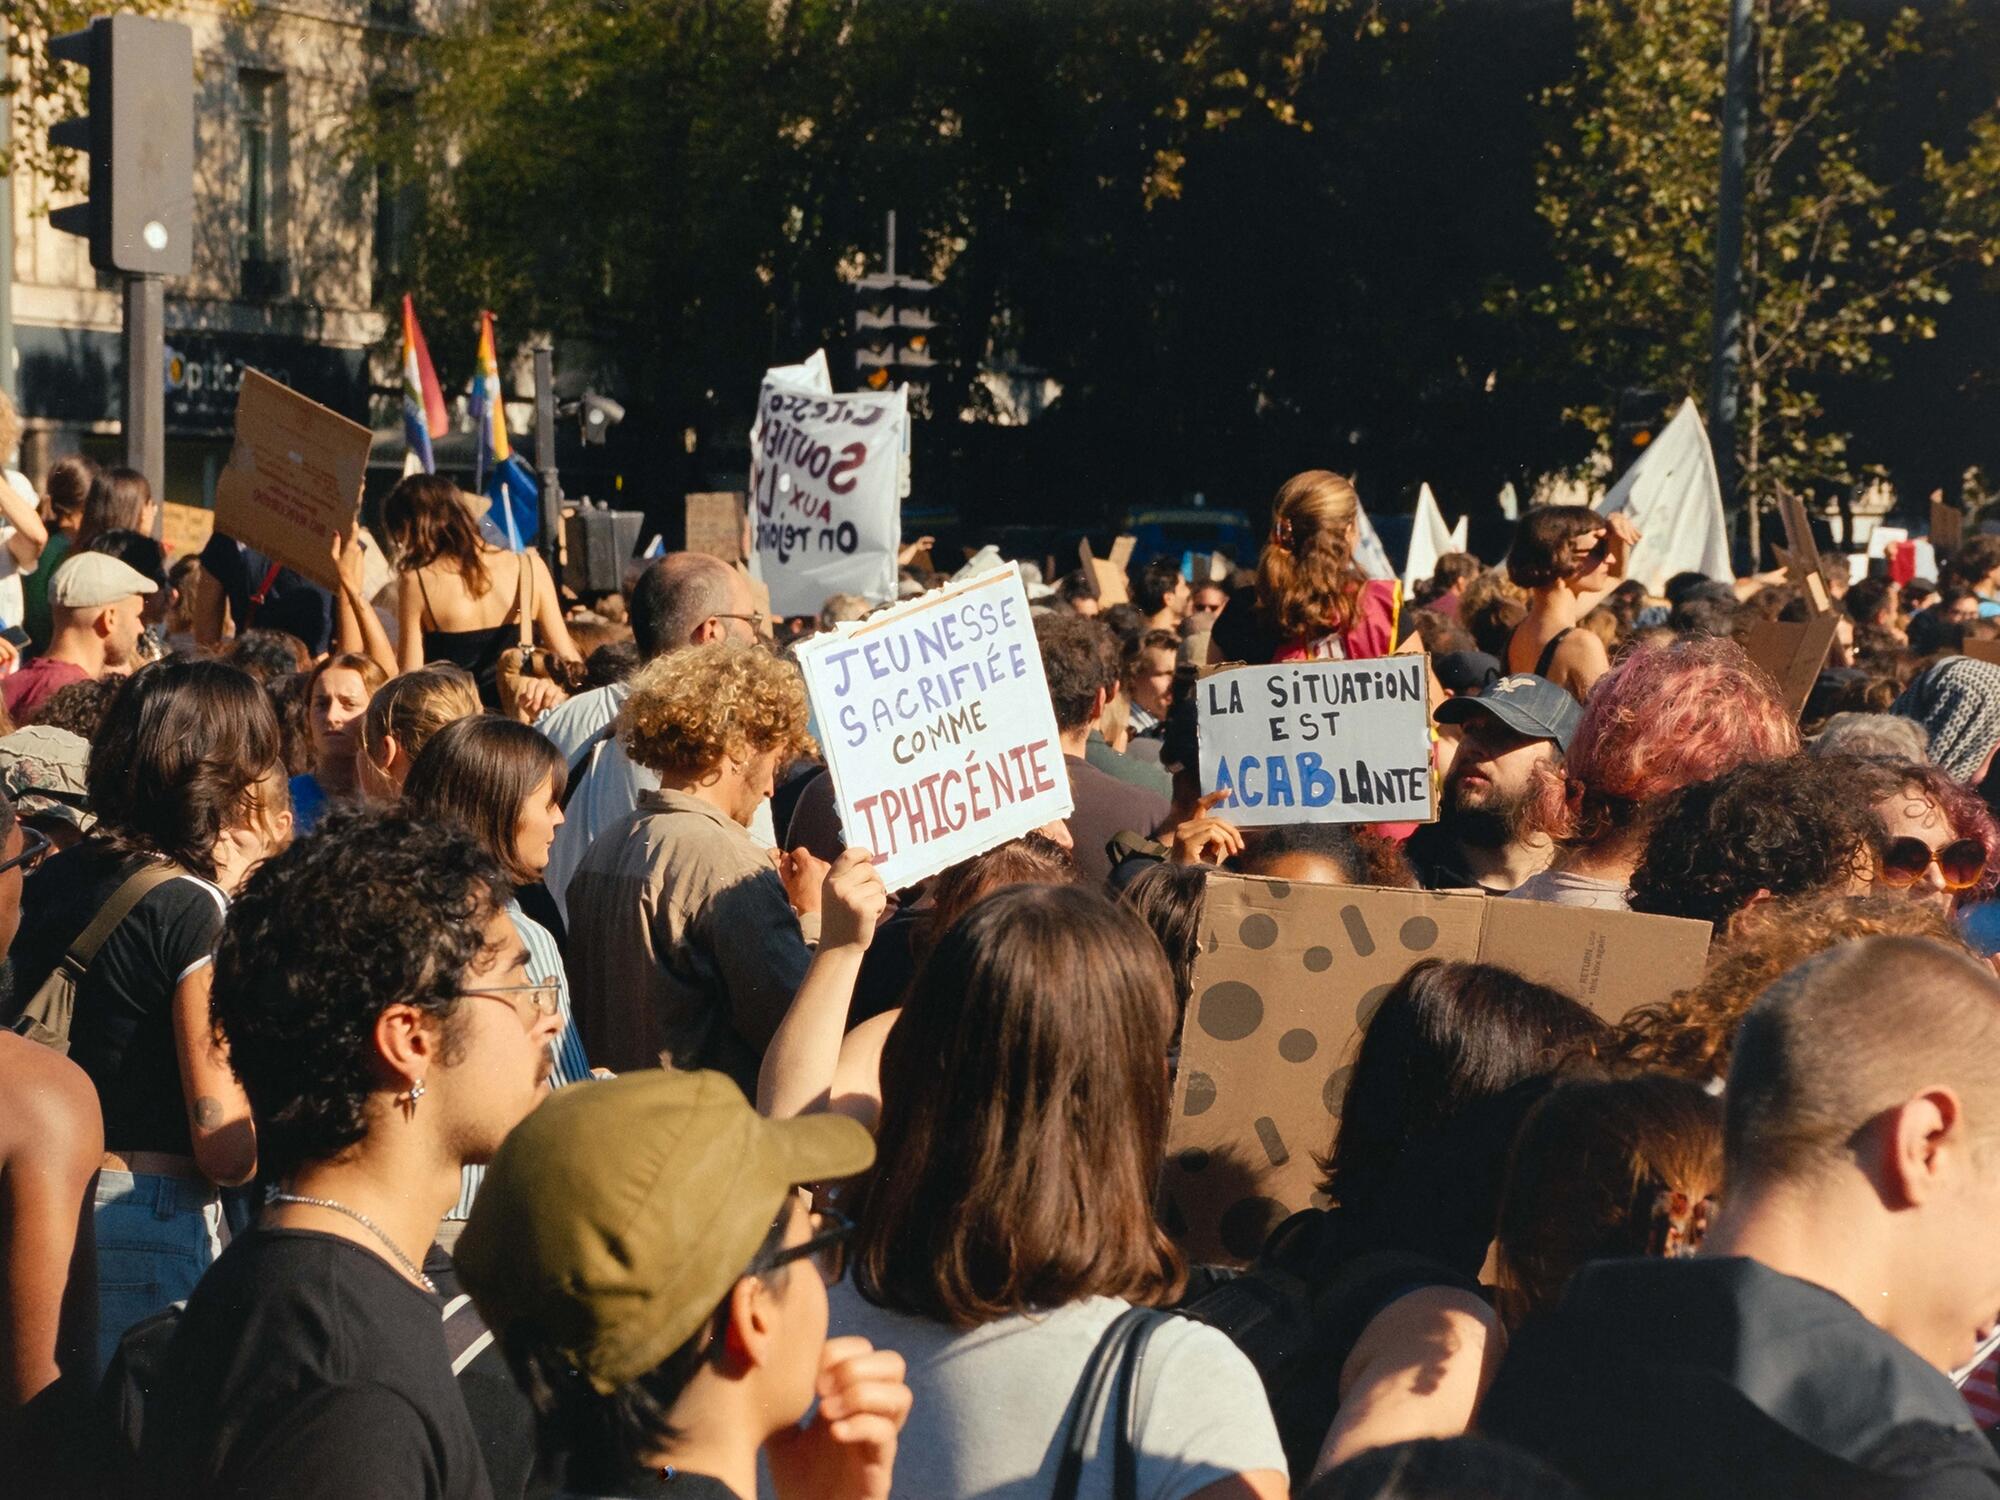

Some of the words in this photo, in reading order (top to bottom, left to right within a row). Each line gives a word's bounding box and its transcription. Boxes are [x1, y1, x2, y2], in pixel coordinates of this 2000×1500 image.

[825, 596, 1017, 698] JEUNESSE
[839, 642, 1027, 748] SACRIFIÉE
[1209, 680, 1244, 716] LA
[1268, 711, 1341, 742] EST
[892, 700, 988, 765] COMME
[853, 738, 1056, 867] IPHIGÉNIE
[1213, 751, 1428, 810] ACABLANTE
